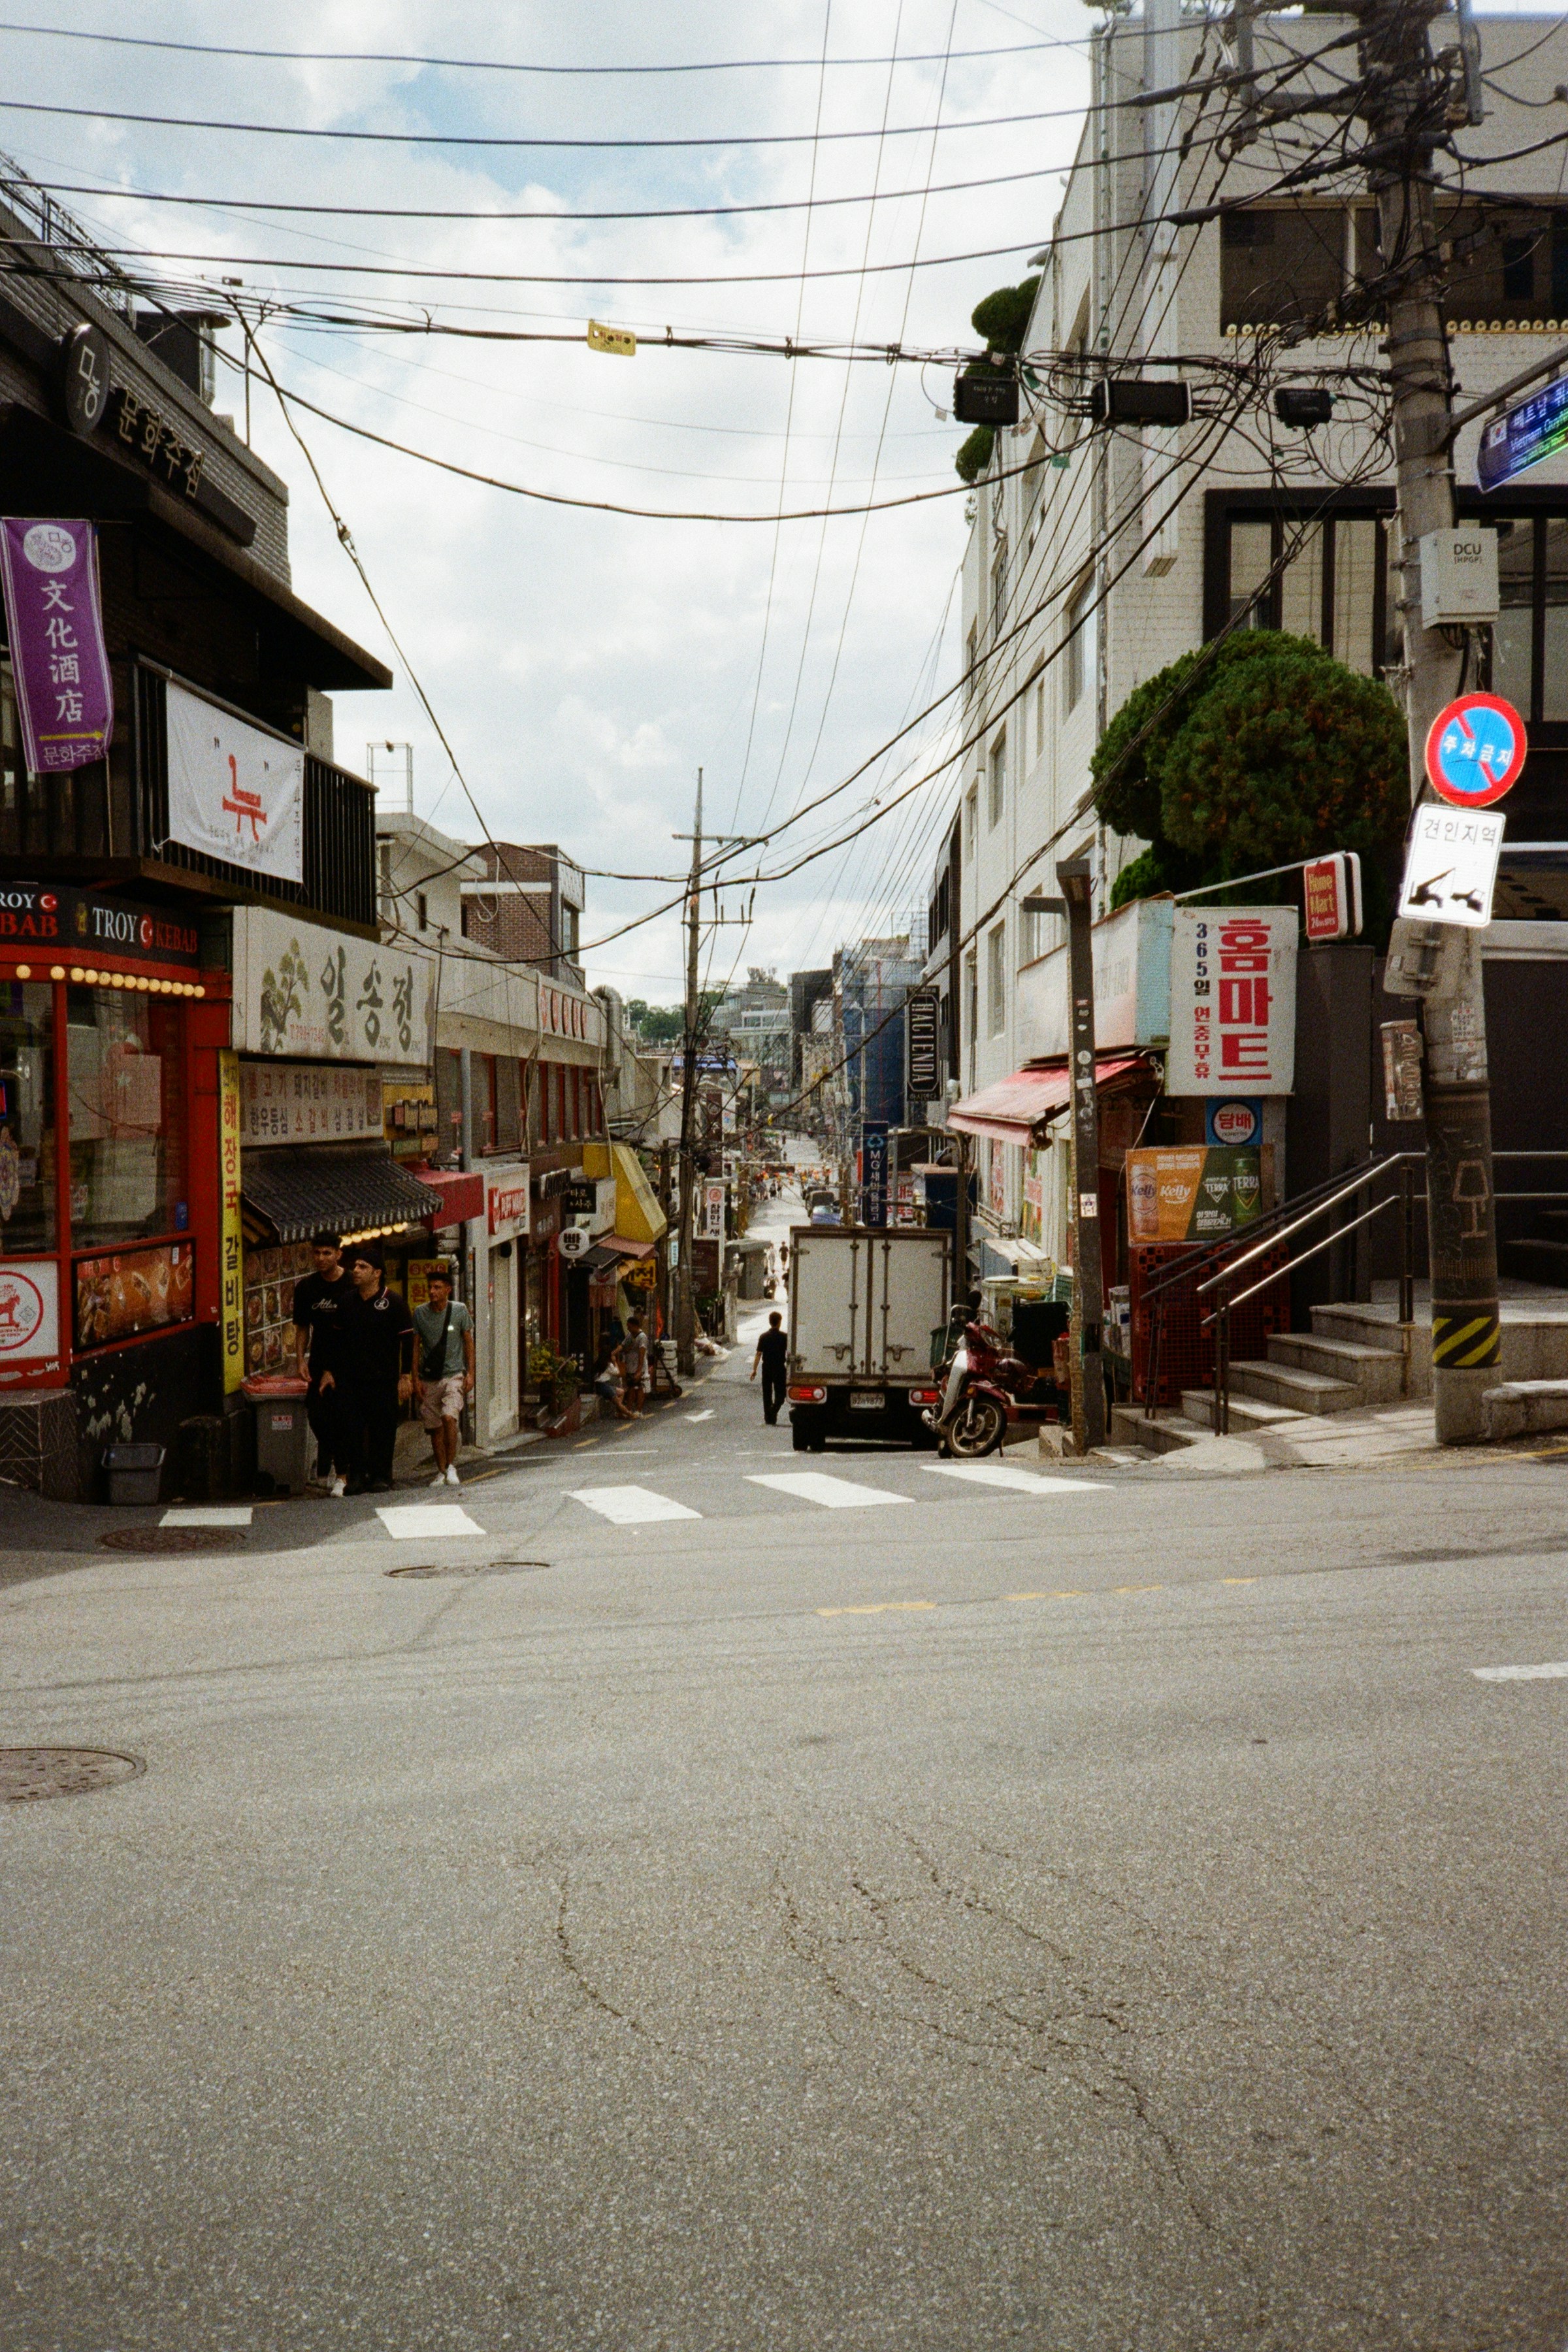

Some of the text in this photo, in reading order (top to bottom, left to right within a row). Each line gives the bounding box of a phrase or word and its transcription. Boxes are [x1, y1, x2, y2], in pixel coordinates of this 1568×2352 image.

[120, 389, 204, 499] 문화주점
[1454, 544, 1482, 555] DCU
[41, 580, 84, 723] 文化酒店
[1443, 735, 1513, 766] 주차금지
[1424, 818, 1497, 847] 견인지역
[1310, 893, 1334, 915] Mart
[93, 907, 139, 943] TROY
[155, 921, 197, 953] KEBAB
[320, 945, 414, 1053] 일송정
[1194, 923, 1210, 1079] 365일 연중무휴
[1218, 919, 1273, 1081] 홈마트
[911, 1003, 935, 1083] HACIENDA
[250, 1107, 288, 1135] 한우등심
[1218, 1113, 1251, 1130] 담배
[223, 1094, 238, 1217] 해장국
[1159, 1184, 1191, 1200] Kelly
[1203, 1182, 1230, 1194] TERRA
[1233, 1175, 1260, 1190] TERRA
[563, 1232, 581, 1251] 빵
[225, 1233, 240, 1356] 갈비탕
